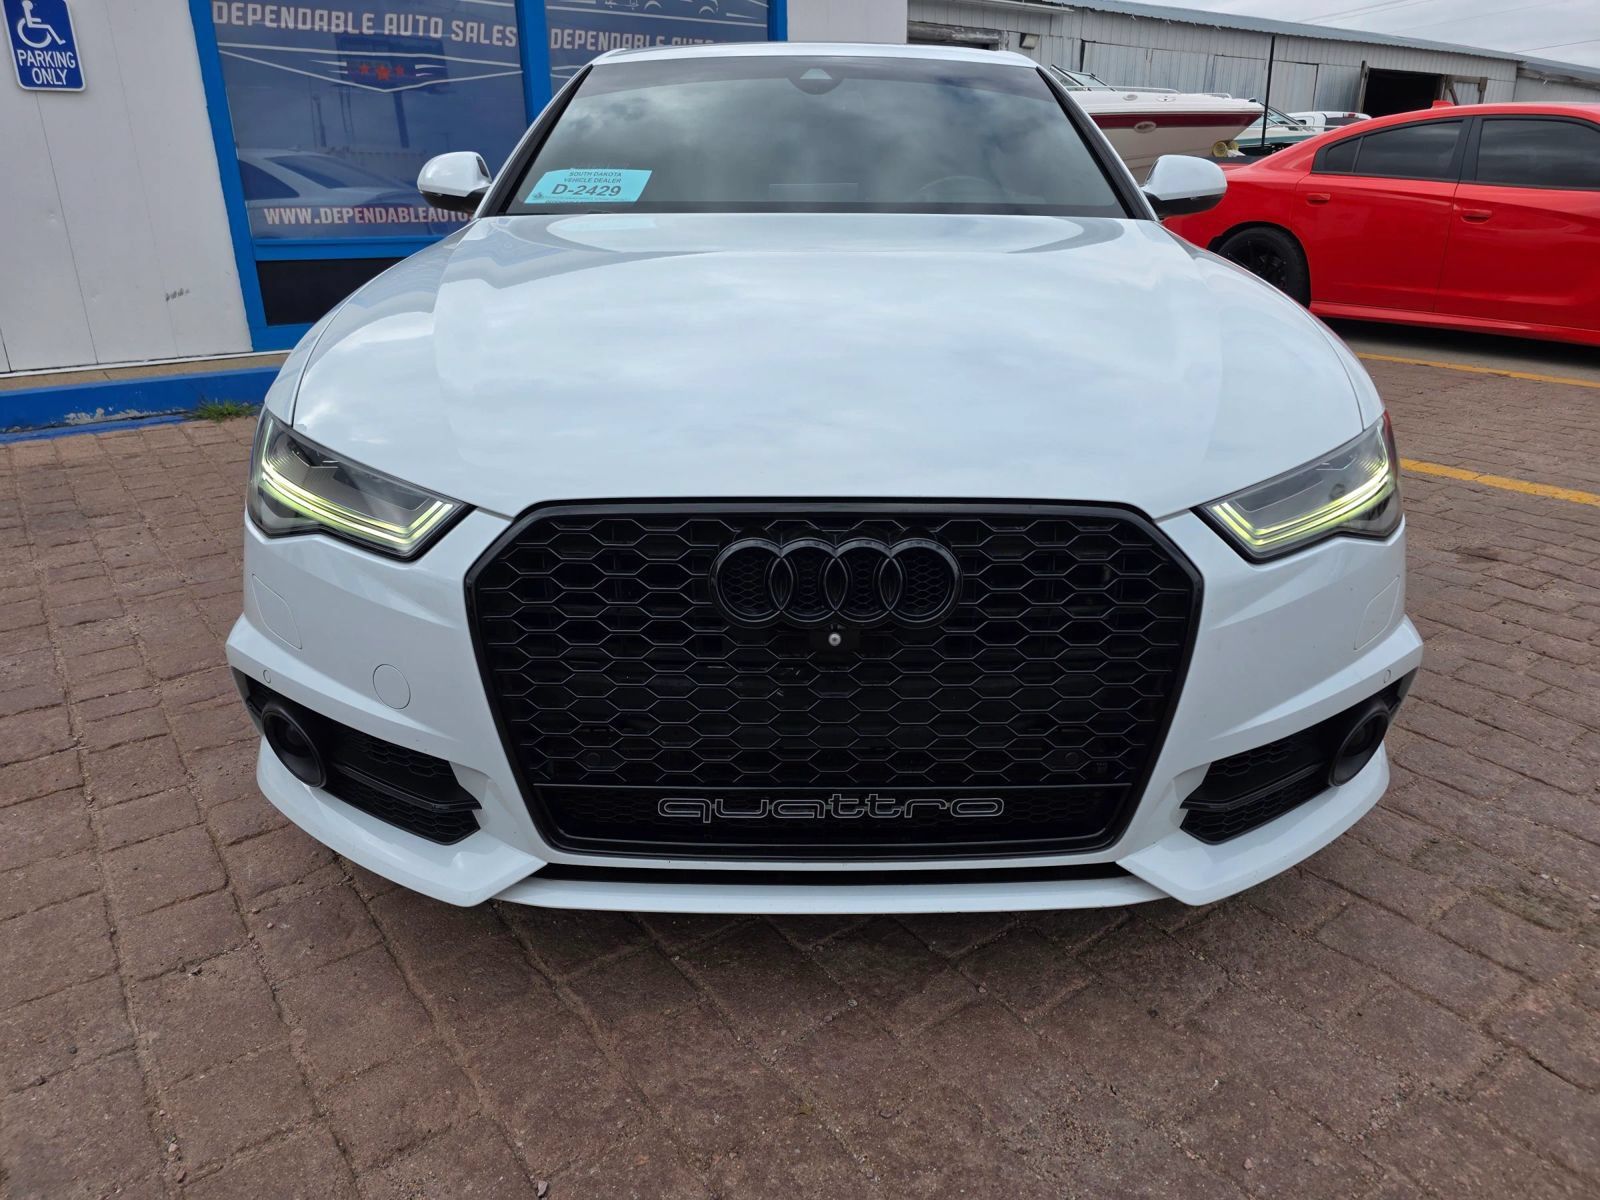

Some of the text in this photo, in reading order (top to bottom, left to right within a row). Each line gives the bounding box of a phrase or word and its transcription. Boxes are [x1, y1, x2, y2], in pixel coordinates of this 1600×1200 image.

[212, 1, 517, 48] DEPENDABLE AUTO SALES
[16, 49, 76, 69] PARKING
[31, 67, 68, 86] ONLY
[551, 183, 622, 196] D-2429
[657, 793, 1005, 824] quattro
